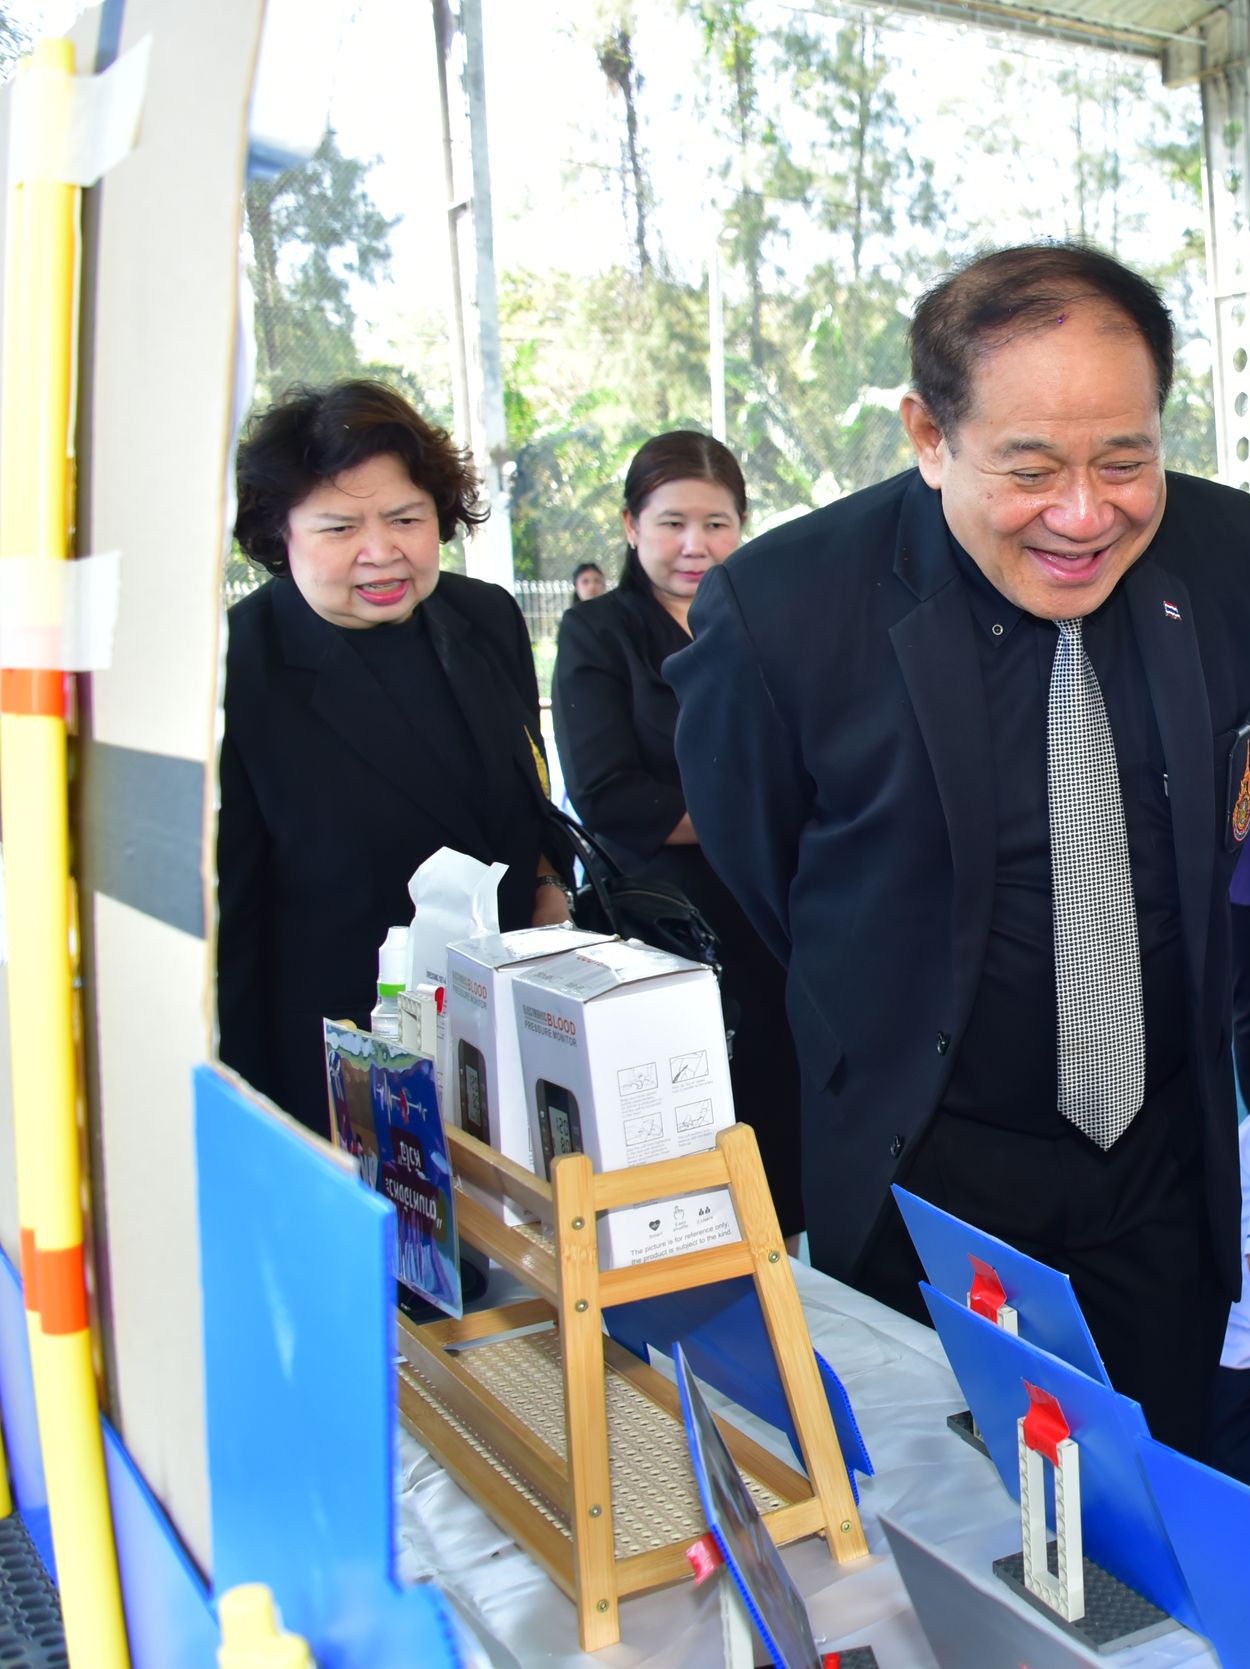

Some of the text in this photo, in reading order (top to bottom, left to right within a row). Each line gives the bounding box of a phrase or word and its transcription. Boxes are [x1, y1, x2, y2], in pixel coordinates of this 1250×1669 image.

[524, 1020, 577, 1047] PRESSURE MONITOR
[546, 1012, 577, 1036] BLOOD
[631, 1248, 643, 1256] The
[645, 1240, 667, 1254] picture
[674, 1235, 683, 1243] for
[684, 1226, 714, 1240] reference
[631, 1257, 642, 1265] the
[643, 1249, 668, 1263] product
[676, 1240, 699, 1252] subject
[707, 1232, 717, 1241] the
